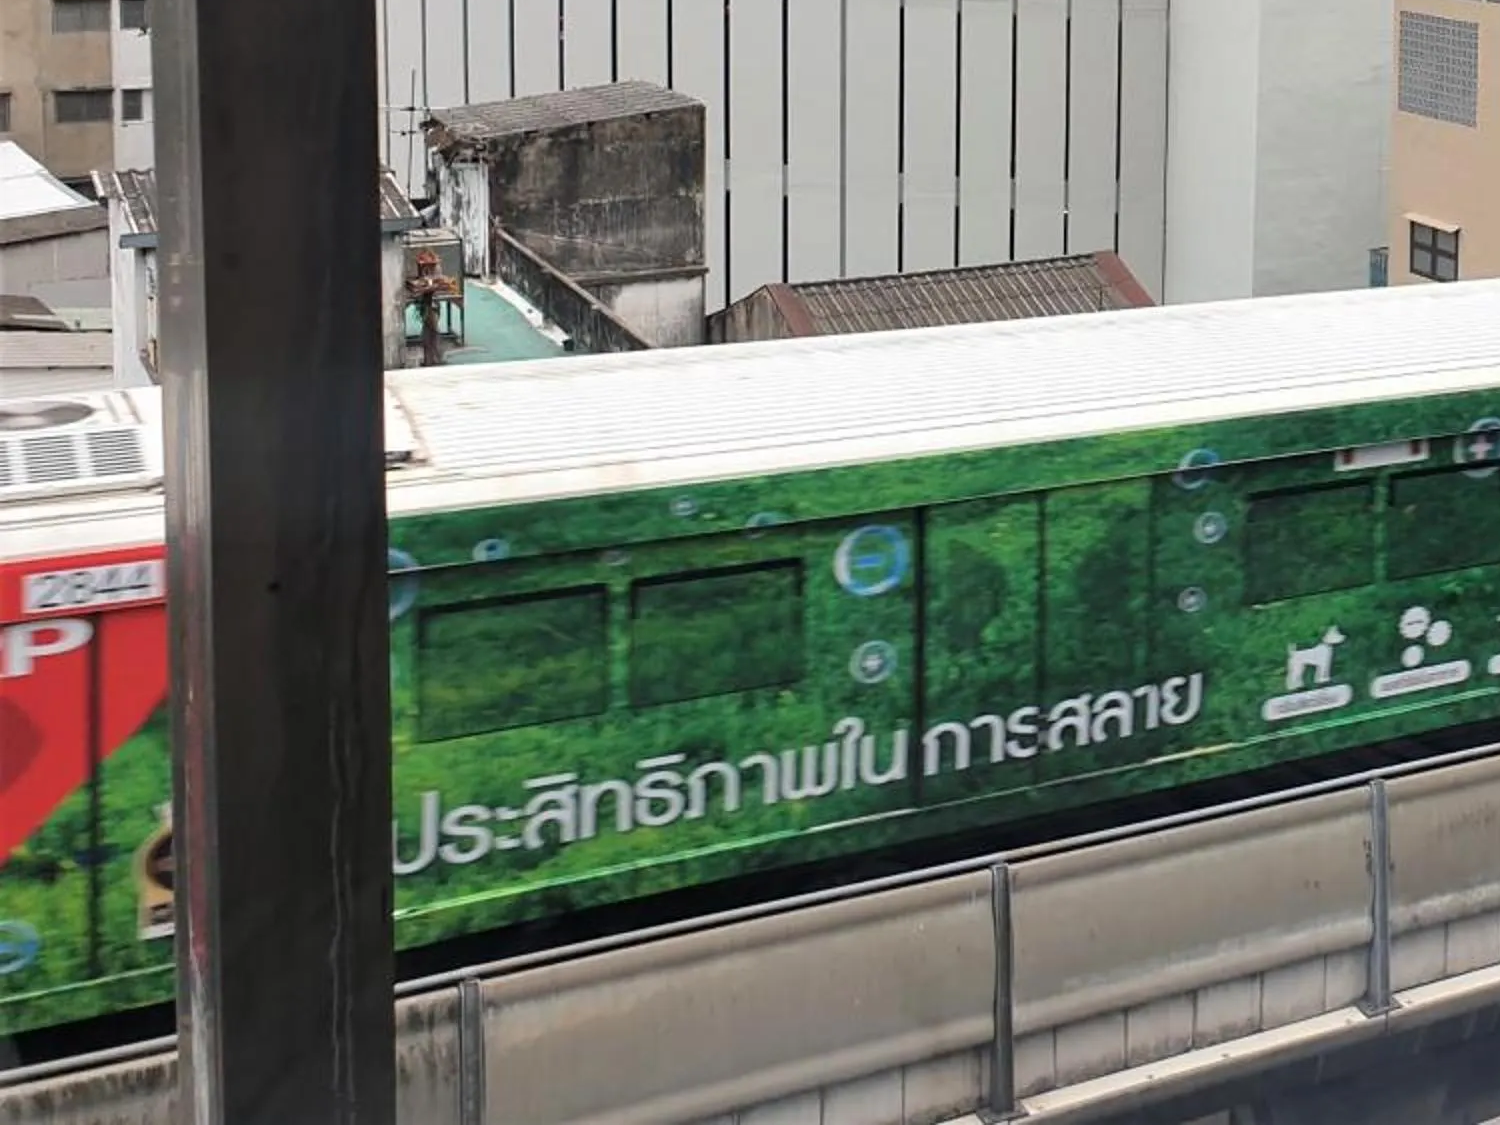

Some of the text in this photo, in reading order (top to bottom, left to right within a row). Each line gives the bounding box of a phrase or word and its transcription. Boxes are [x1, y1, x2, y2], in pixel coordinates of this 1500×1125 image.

[31, 565, 154, 609] 2844
[923, 672, 1203, 777] การสลาย
